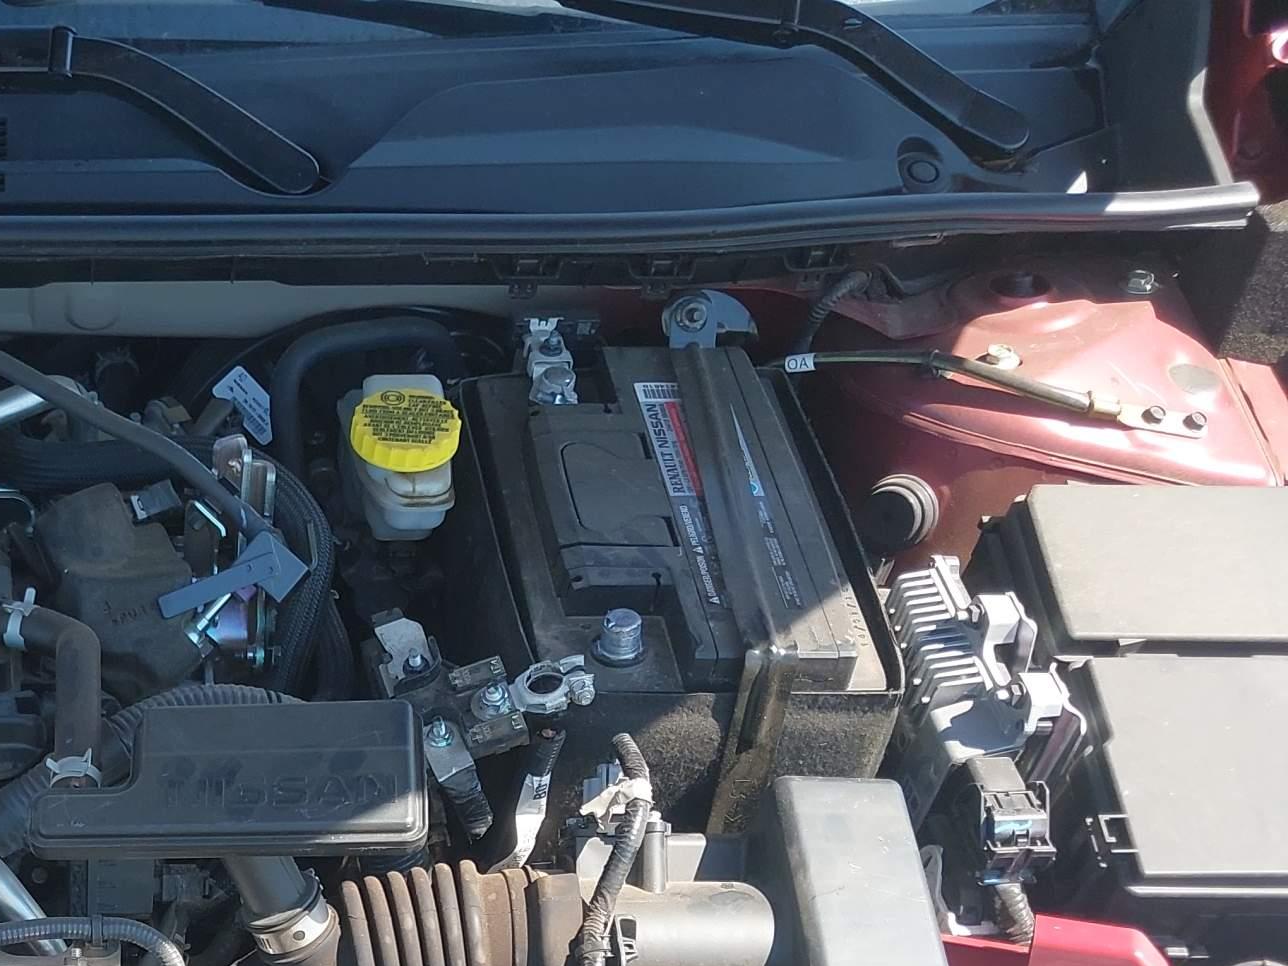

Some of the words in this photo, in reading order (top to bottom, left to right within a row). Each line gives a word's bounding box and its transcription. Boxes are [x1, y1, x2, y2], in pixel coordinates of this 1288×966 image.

[644, 404, 669, 448] NISSAN
[661, 452, 685, 493] RENAULT
[165, 774, 400, 808] NISSAN
